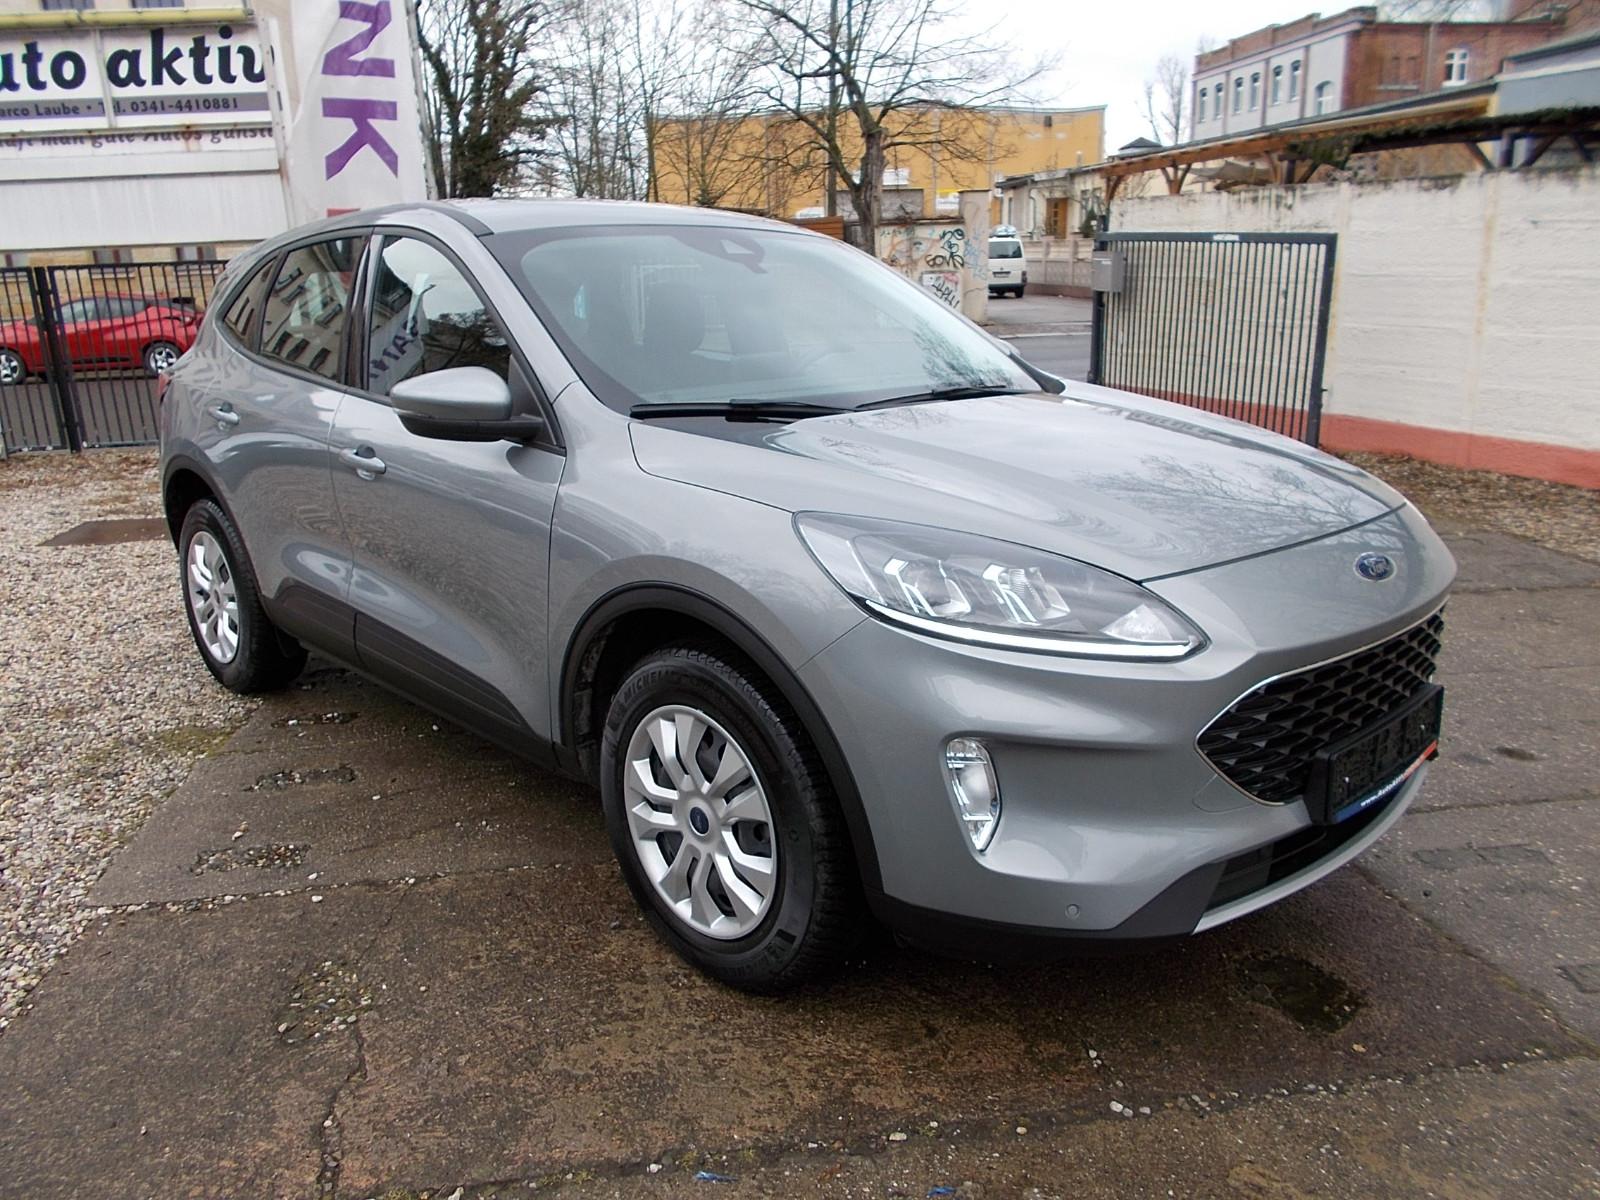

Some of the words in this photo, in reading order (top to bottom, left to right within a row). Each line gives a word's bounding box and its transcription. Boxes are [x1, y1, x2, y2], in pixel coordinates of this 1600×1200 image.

[106, 26, 275, 88] aktiv
[34, 103, 80, 116] Laube
[97, 101, 126, 115] Tl.
[130, 97, 238, 113] 0341-4410881
